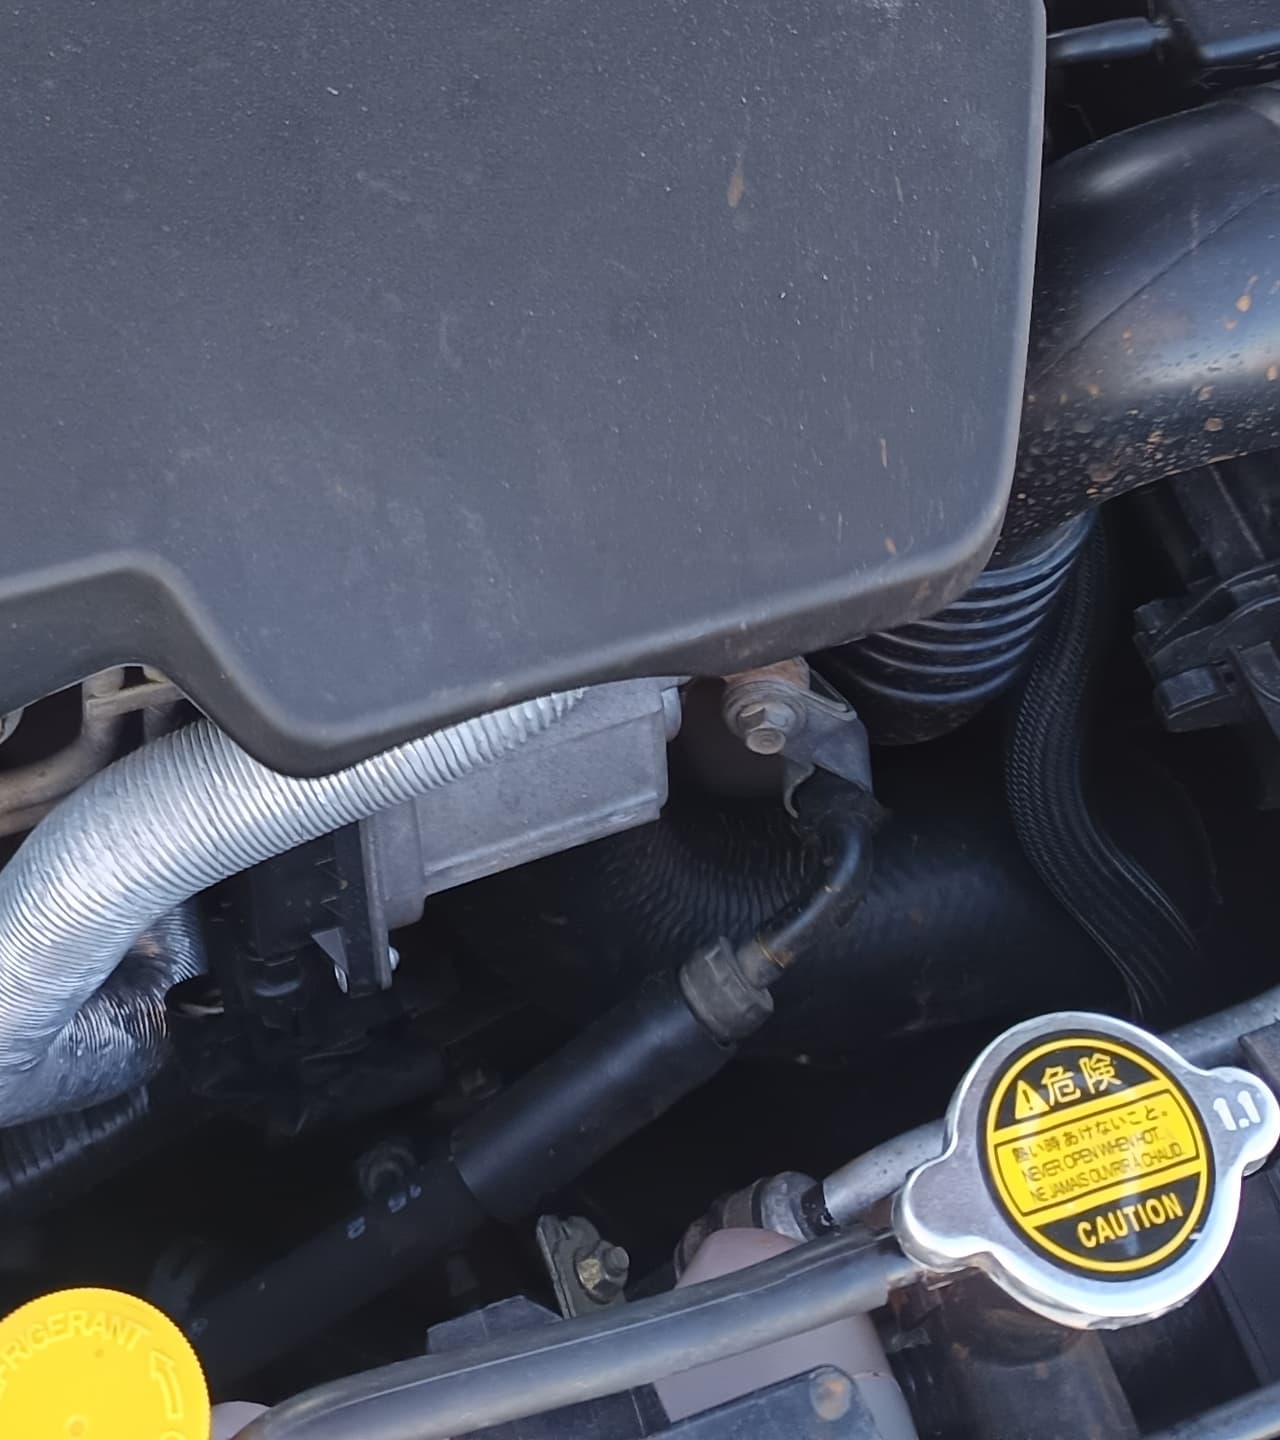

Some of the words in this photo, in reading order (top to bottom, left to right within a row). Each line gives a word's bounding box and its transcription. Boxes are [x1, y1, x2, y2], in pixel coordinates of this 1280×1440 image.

[1040, 1051, 1123, 1108] 危険
[1212, 1089, 1262, 1132] 1.1
[1021, 1159, 1065, 1183] NEVER
[1063, 1146, 1099, 1170] OPEN
[1097, 1133, 1135, 1159] WHEN
[1029, 1184, 1049, 1204] NE
[1049, 1170, 1091, 1200] JAMAIS
[1076, 1191, 1185, 1249] CAUTION
